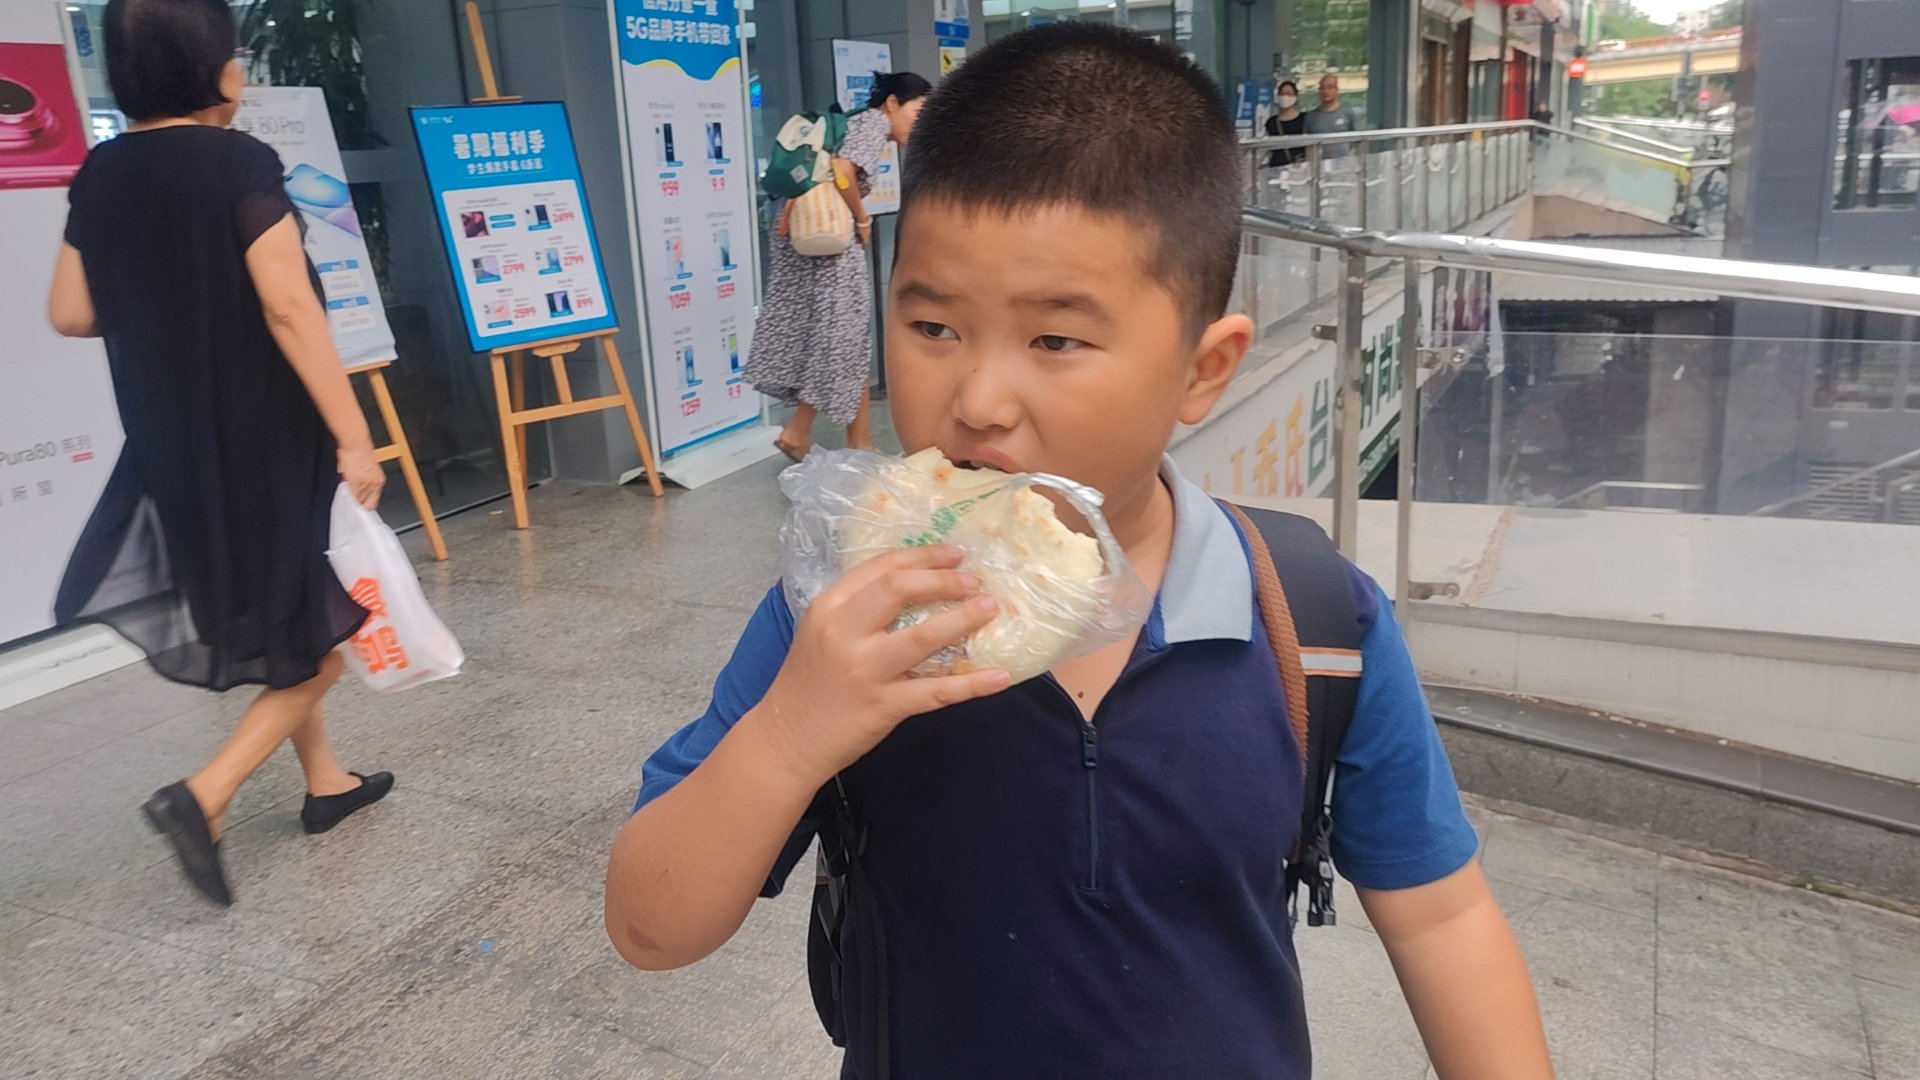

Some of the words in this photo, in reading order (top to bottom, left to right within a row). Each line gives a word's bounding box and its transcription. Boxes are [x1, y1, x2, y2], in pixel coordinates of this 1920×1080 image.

[280, 115, 305, 134] Pro
[452, 128, 546, 160] 暑期福利季
